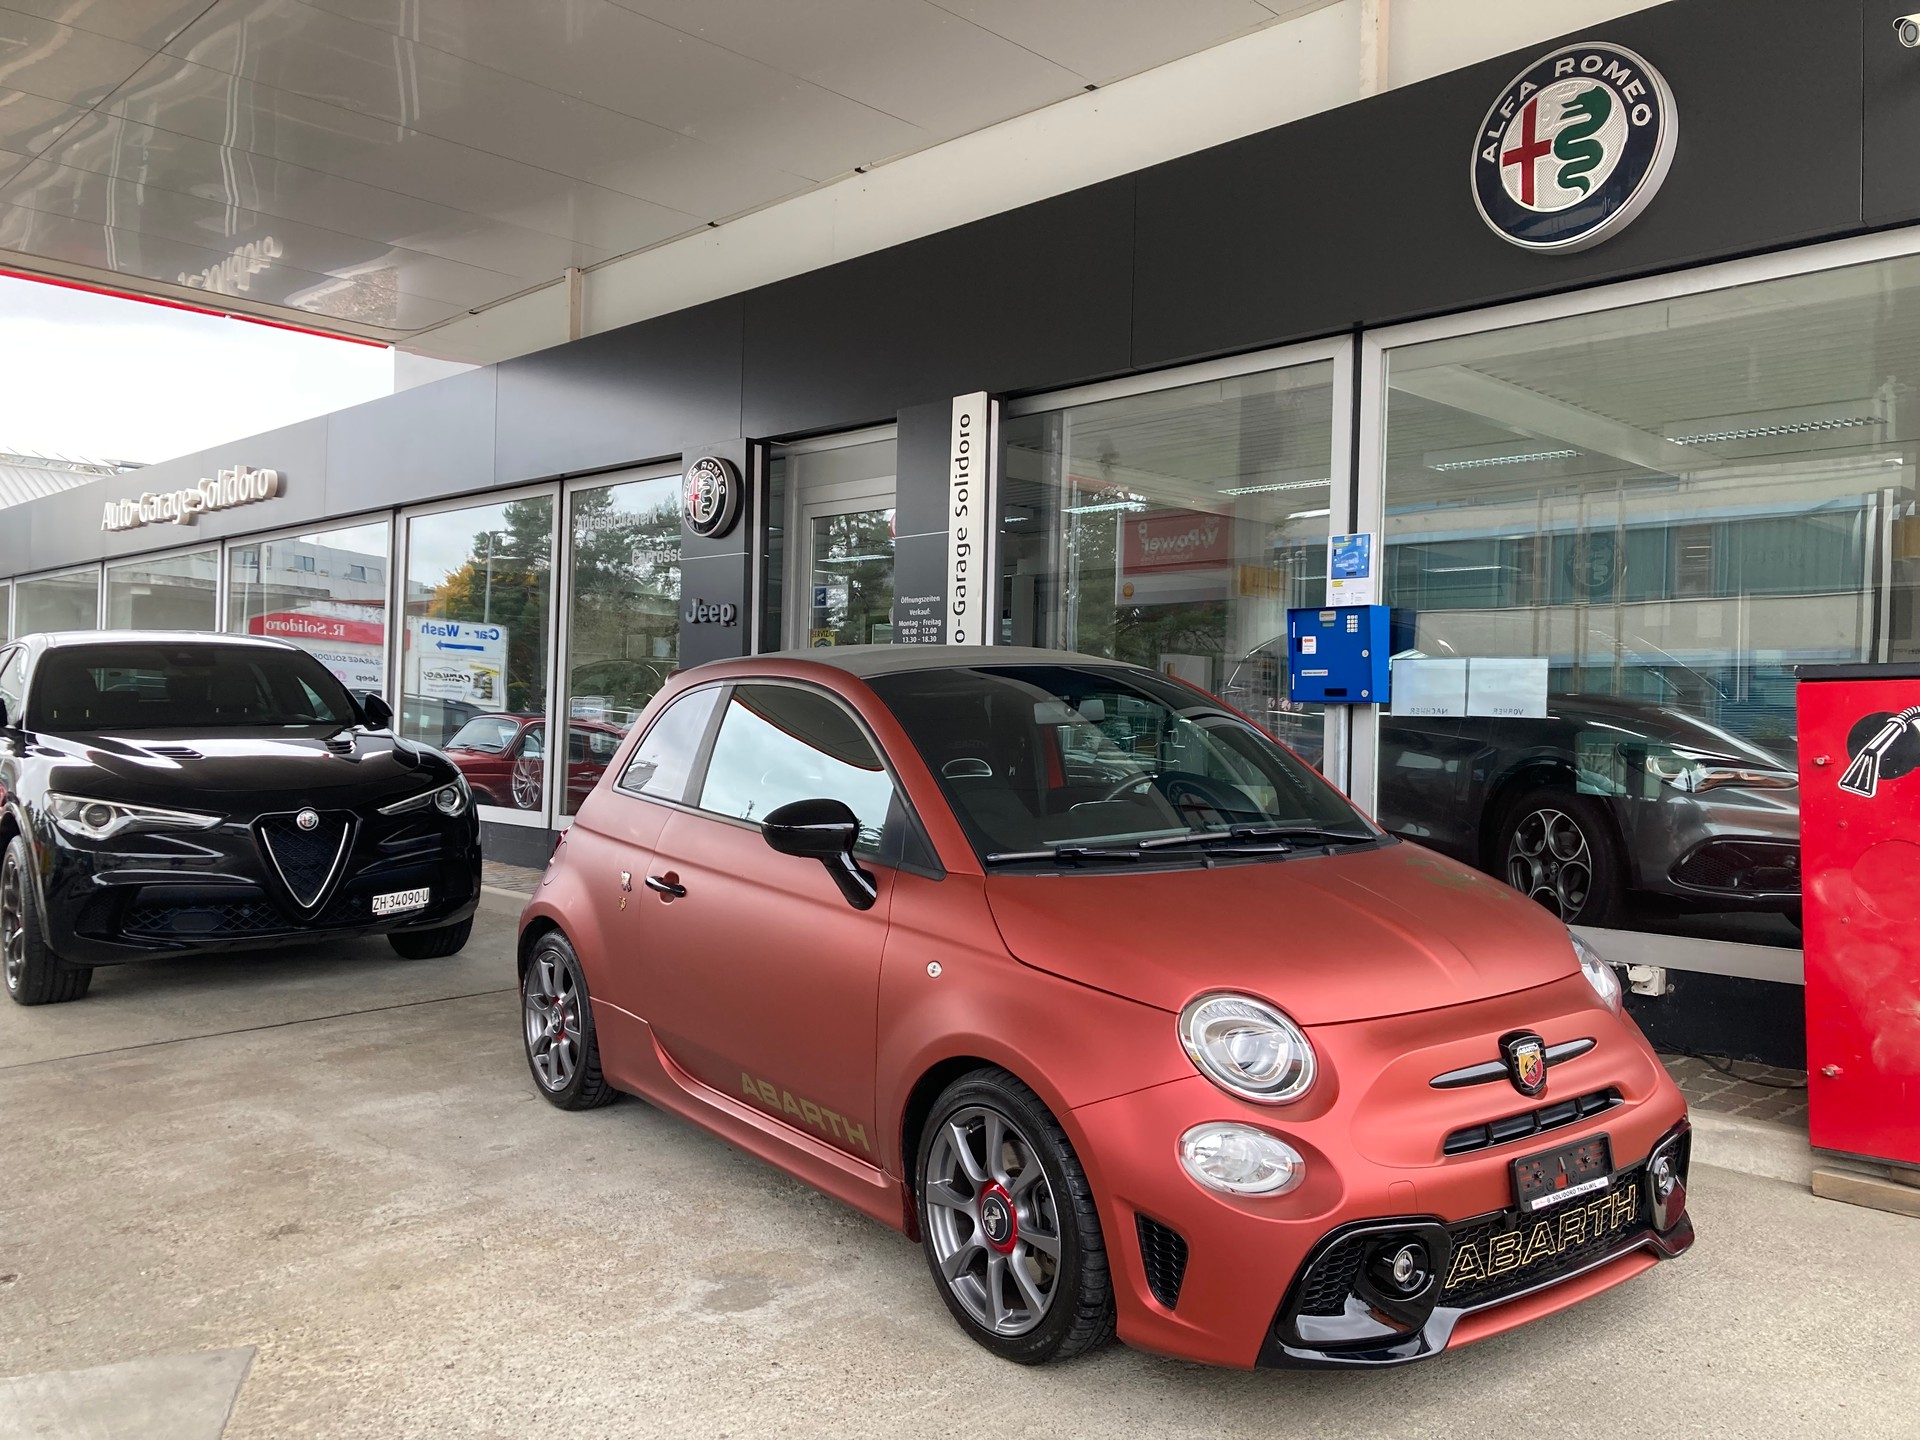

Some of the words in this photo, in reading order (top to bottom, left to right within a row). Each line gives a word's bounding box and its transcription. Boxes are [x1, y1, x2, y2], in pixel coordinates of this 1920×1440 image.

[1482, 81, 1538, 163] ALFA
[1554, 55, 1652, 126] ROMEO
[197, 465, 279, 512] Solidoro
[701, 461, 725, 494] ROMEO
[954, 413, 971, 518] Solidoro
[685, 598, 735, 626] Jeep
[741, 1072, 870, 1152] ABARTH
[1445, 1184, 1636, 1289] ABARTH
